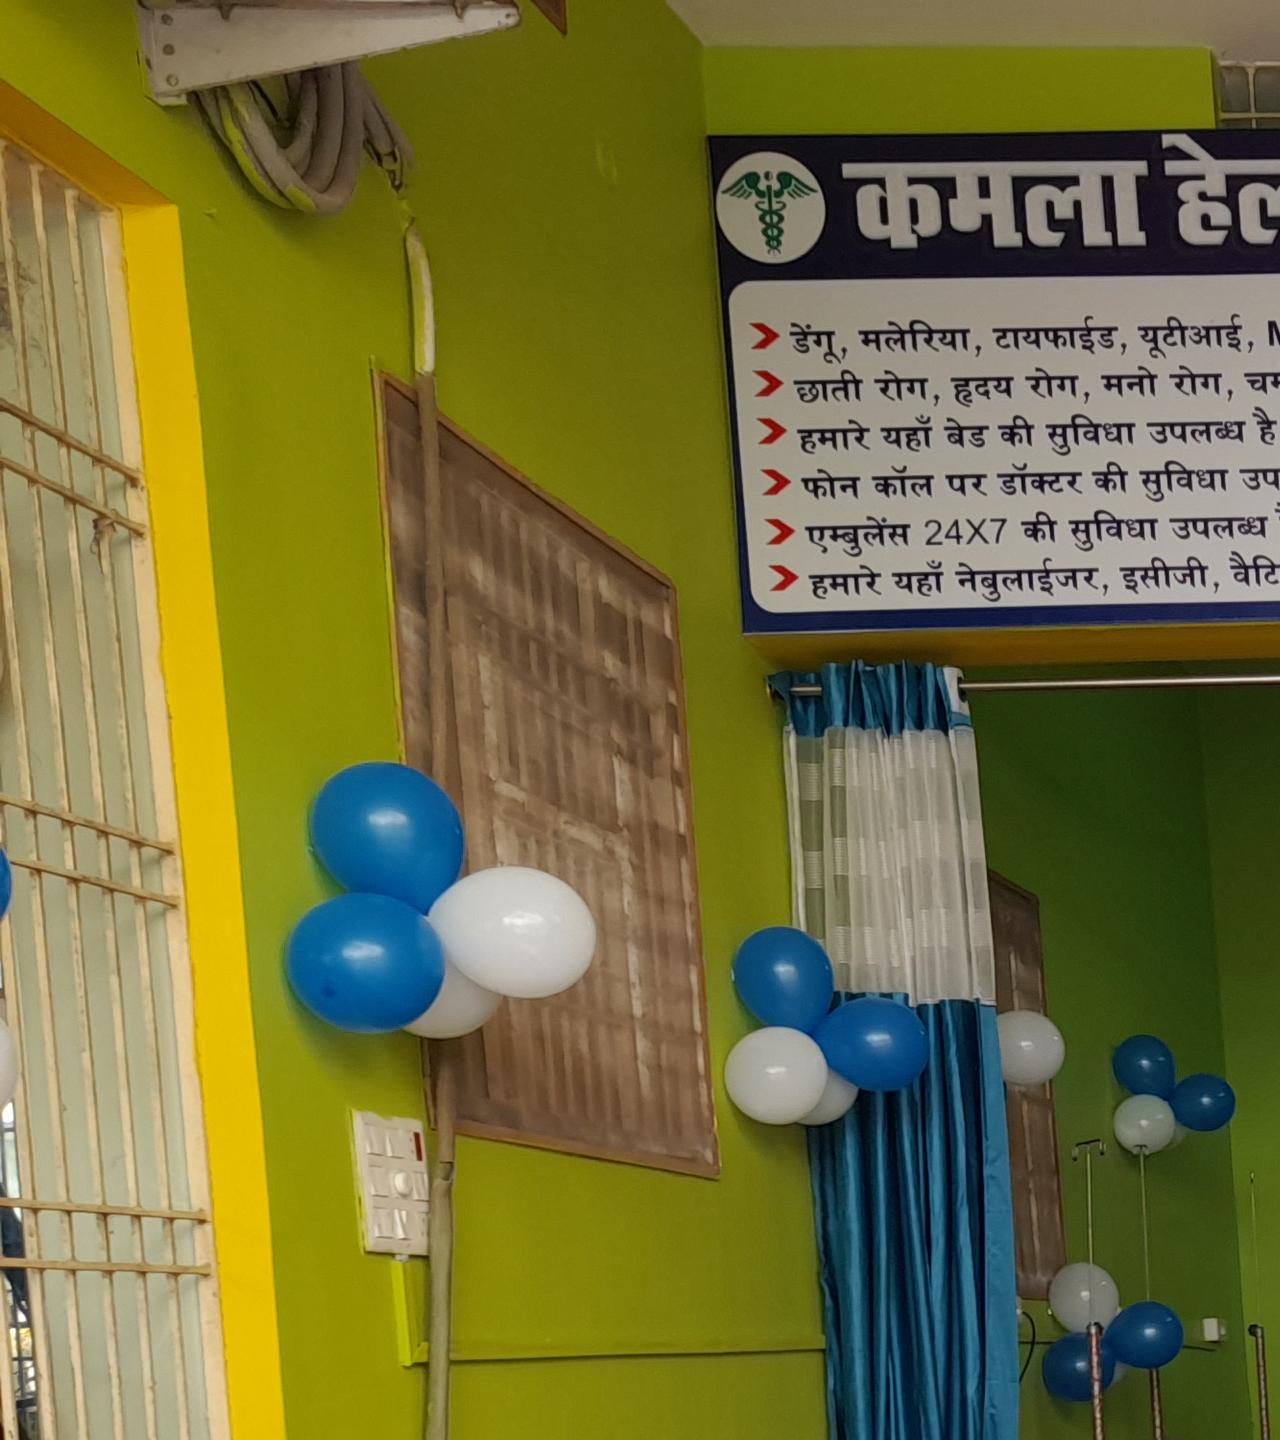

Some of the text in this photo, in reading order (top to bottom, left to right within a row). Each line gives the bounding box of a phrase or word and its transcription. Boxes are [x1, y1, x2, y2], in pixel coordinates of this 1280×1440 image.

[843, 161, 1147, 247] कमला
[789, 323, 847, 364] डेंगू,
[858, 320, 981, 357] मलेरिया,
[992, 316, 1127, 355] टायफाईड,
[1138, 314, 1253, 358] यूटीआई,
[793, 370, 863, 403] छाती
[874, 370, 939, 406] रोग,
[950, 377, 1014, 407] हृदय
[1025, 368, 1089, 403] रोग,
[1101, 366, 1158, 396] मनो
[1169, 365, 1233, 400] रोग,
[797, 419, 870, 454] हमारे
[880, 415, 932, 452] यहाँ
[944, 418, 989, 448] बेड
[998, 415, 1034, 446] की
[1045, 414, 1136, 456] सुविधा
[1147, 421, 1246, 443] उपलब्ध
[801, 469, 860, 499] फोन
[872, 466, 934, 498] कॉल
[945, 474, 987, 496] पर
[997, 463, 1082, 495] डॉक्टर
[1092, 462, 1128, 493] की
[1139, 461, 1228, 502] सुविधा
[805, 516, 910, 557] एम्बुलेंस
[925, 519, 1007, 545] 24X7
[1021, 511, 1057, 542] की
[1069, 510, 1158, 551] सुविधा
[1169, 517, 1268, 539] उपलब्ध
[808, 565, 881, 599] हमारे
[892, 560, 944, 596] यहाँ
[955, 558, 1108, 602] नेबुलाईजर,
[1120, 557, 1219, 594] इसीजी,
